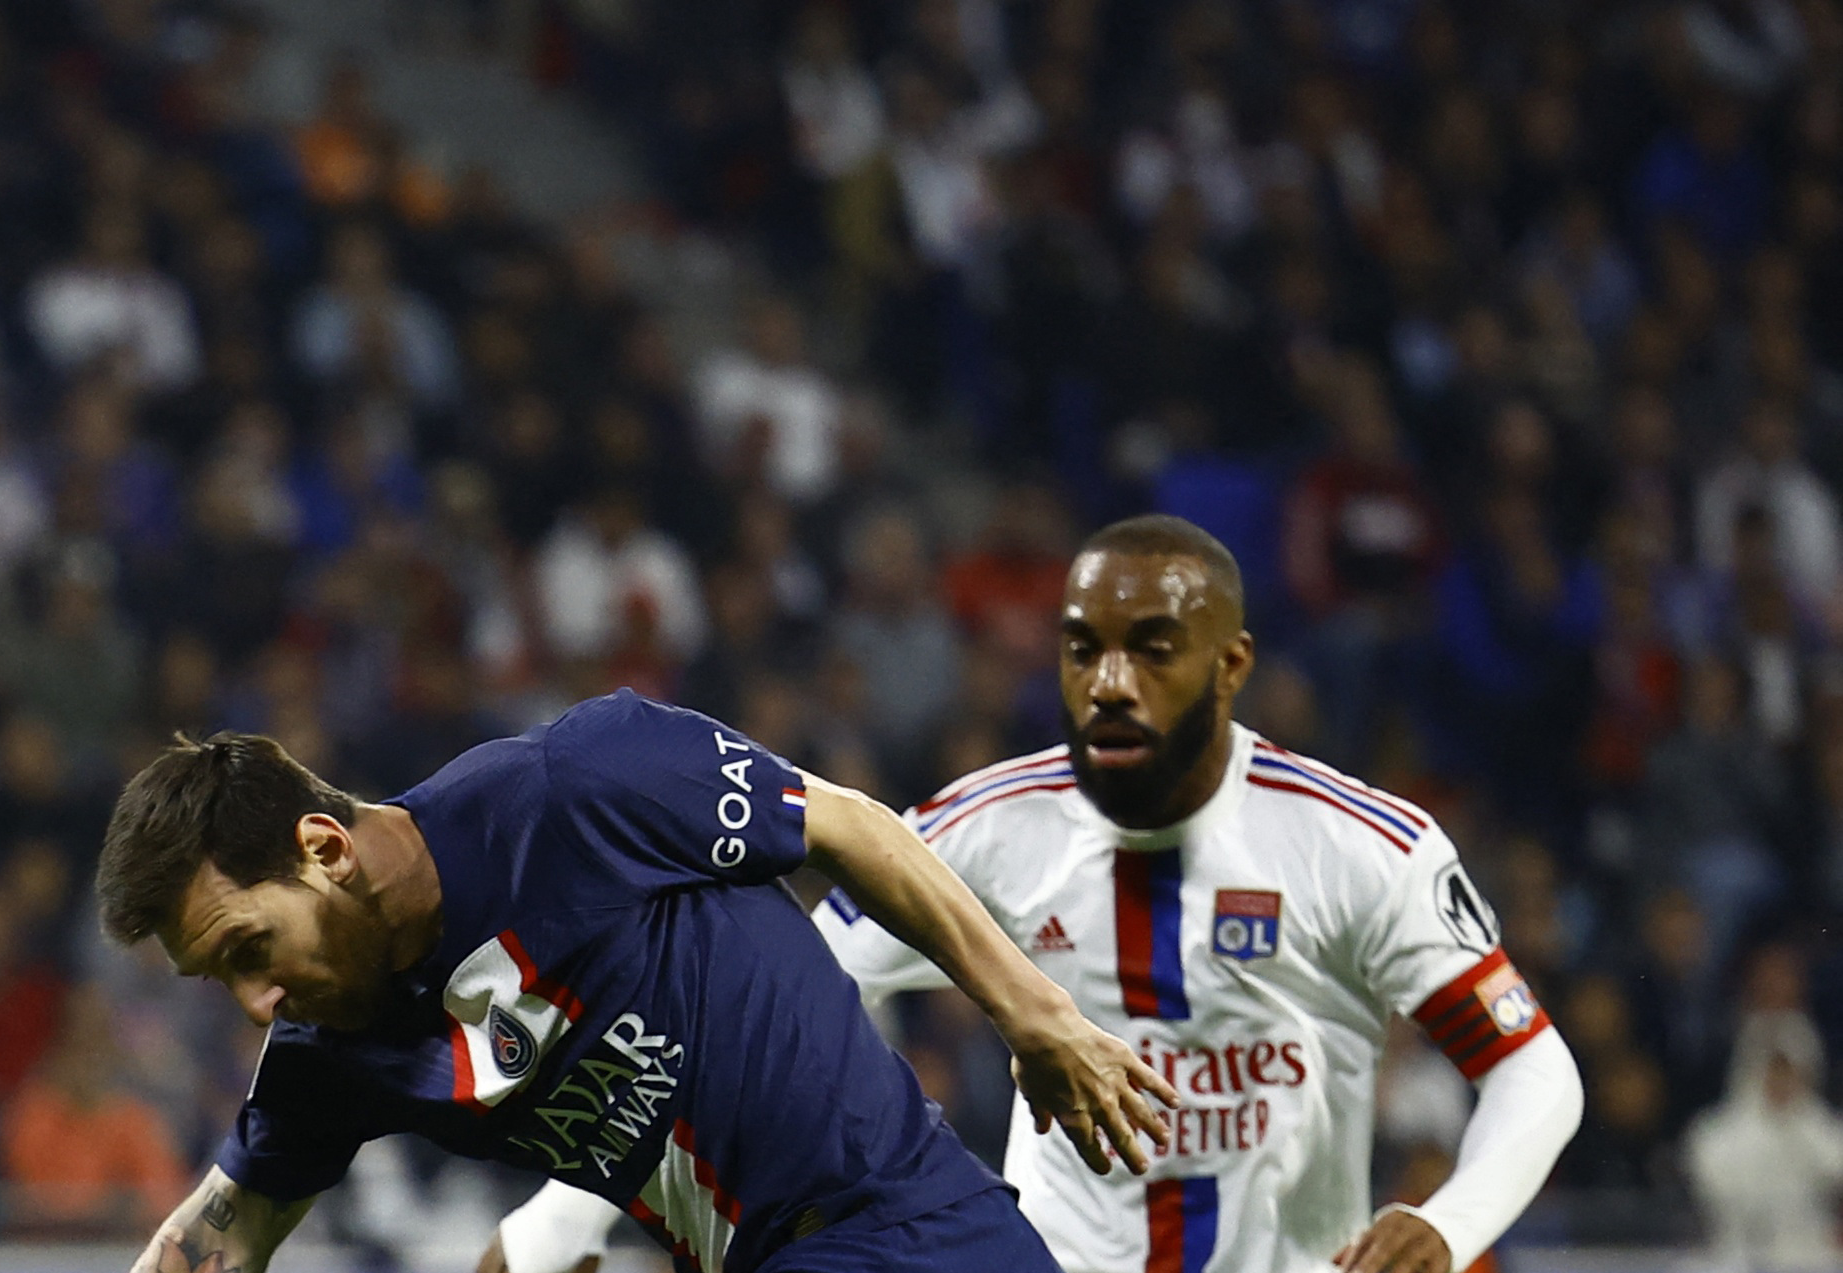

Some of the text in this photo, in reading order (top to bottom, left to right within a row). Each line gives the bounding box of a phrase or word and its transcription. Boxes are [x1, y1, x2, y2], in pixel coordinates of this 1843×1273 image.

[711, 731, 754, 868] GOAT
[1217, 917, 1274, 955] OL
[508, 1012, 667, 1170] ATAR
[1137, 1037, 1307, 1095] irates
